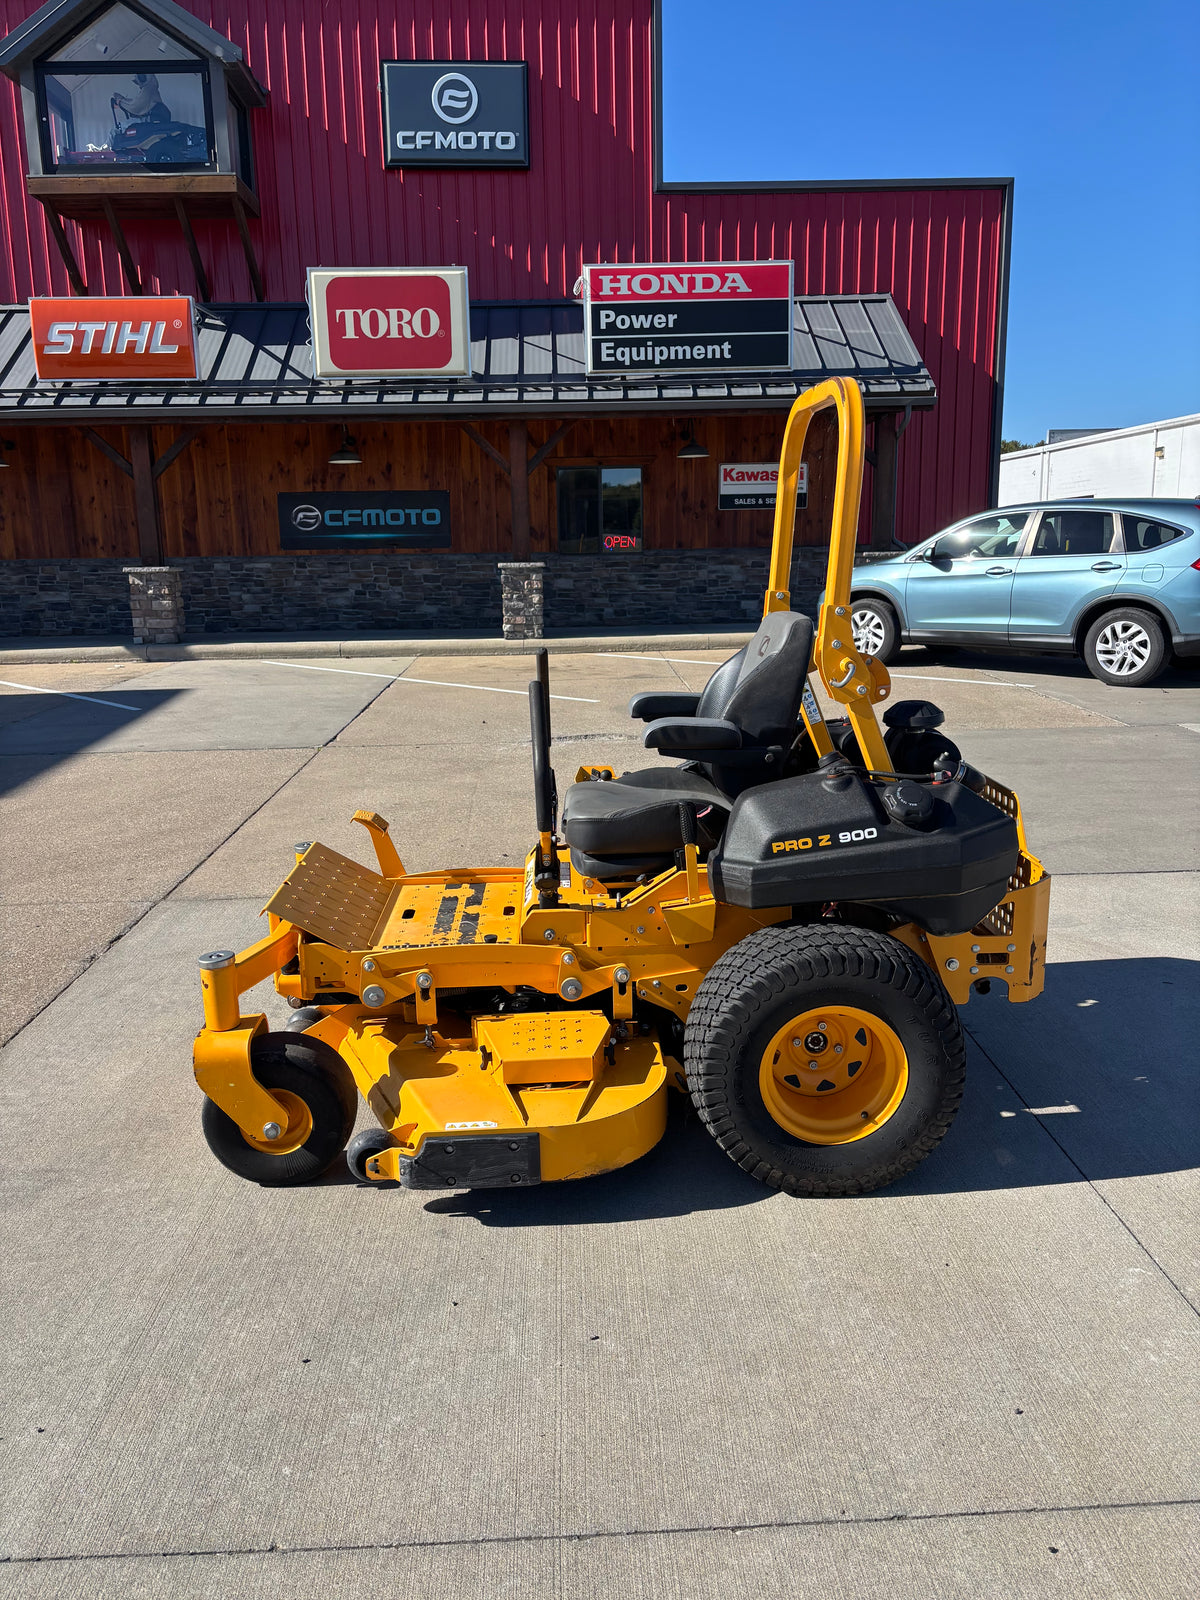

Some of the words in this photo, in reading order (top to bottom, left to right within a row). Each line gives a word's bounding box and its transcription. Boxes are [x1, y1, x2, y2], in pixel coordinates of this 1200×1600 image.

[396, 131, 516, 150] CFMOTO
[598, 272, 752, 296] HONDA
[335, 307, 441, 339] TORO
[600, 309, 678, 330] Power
[43, 321, 179, 355] STIHL
[600, 341, 732, 366] Equipment
[722, 466, 805, 483] Kawasi
[324, 508, 441, 526] CFMOTO
[604, 536, 636, 549] OPEN
[771, 837, 813, 854] PRO
[817, 834, 832, 847] Z
[838, 827, 878, 843] 900
